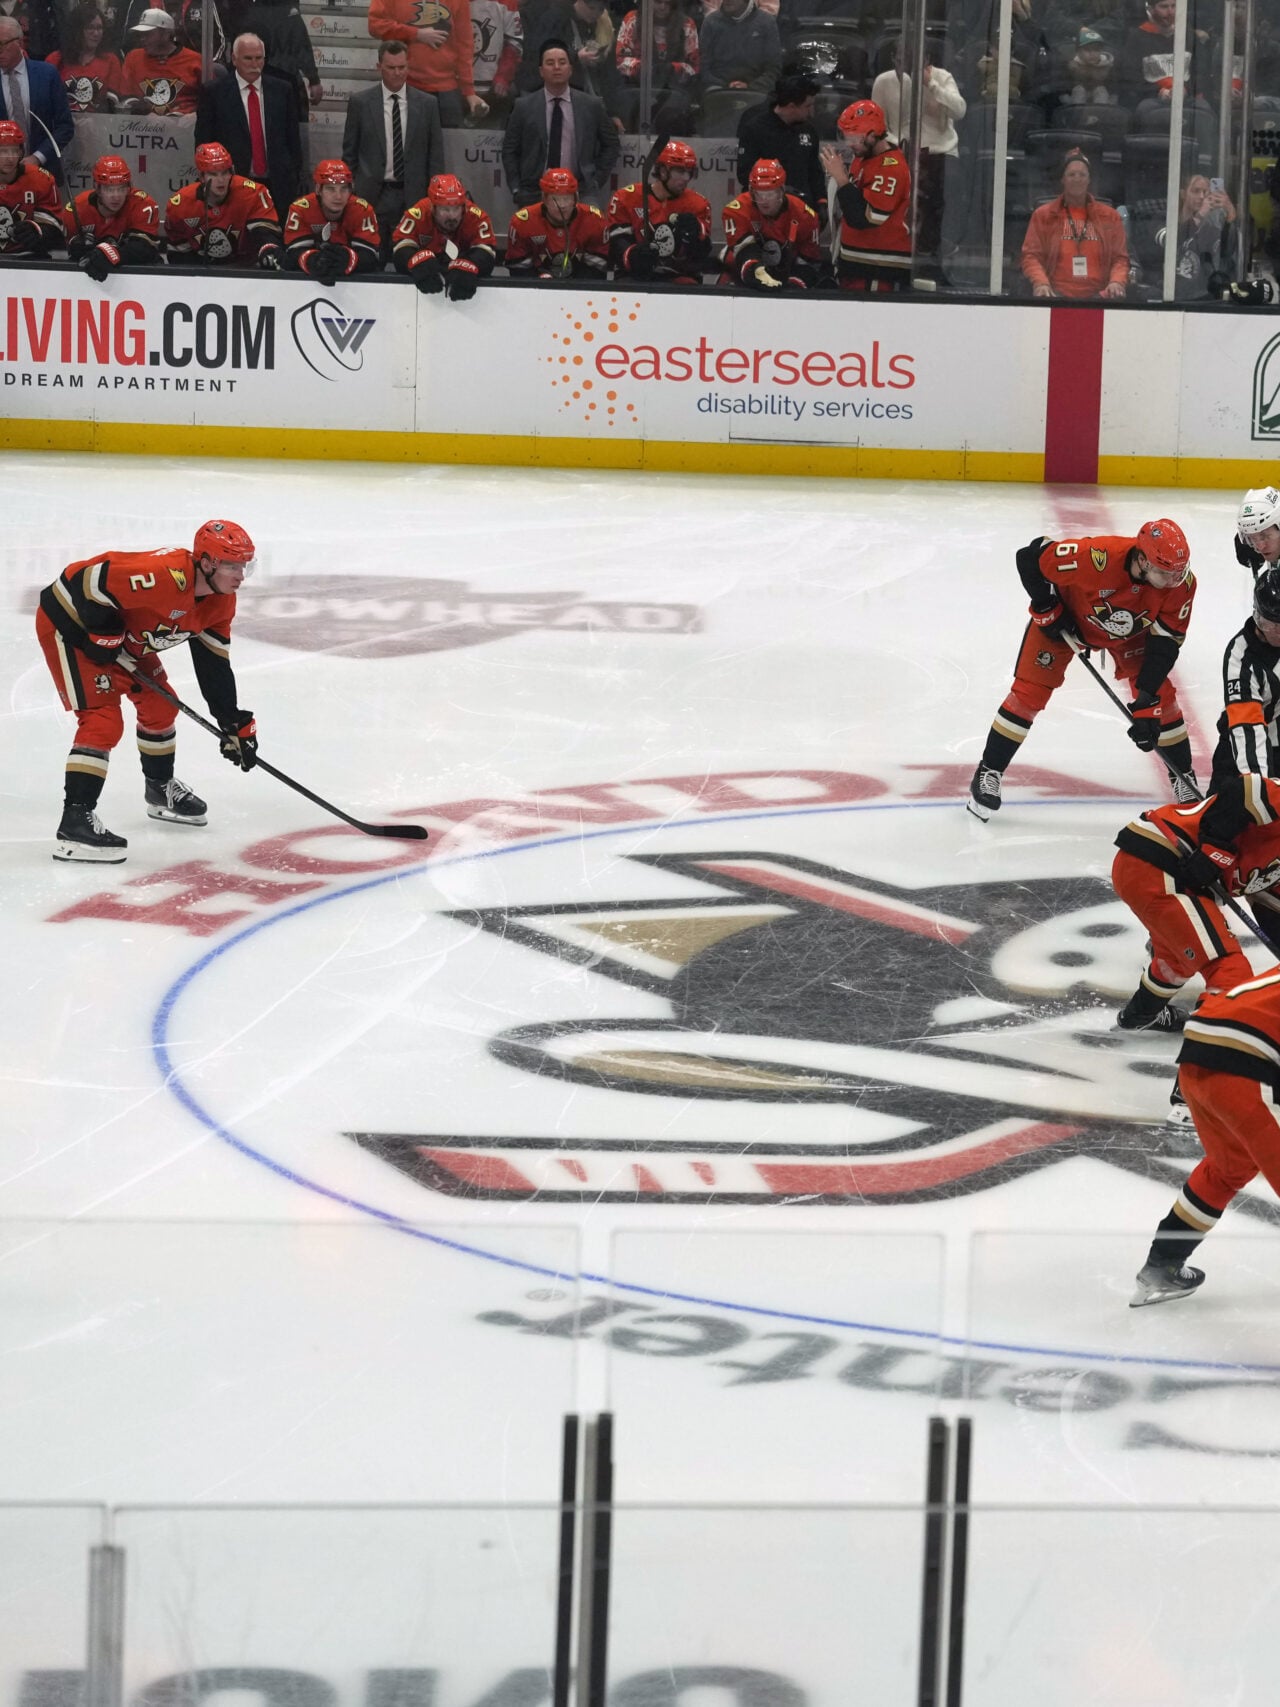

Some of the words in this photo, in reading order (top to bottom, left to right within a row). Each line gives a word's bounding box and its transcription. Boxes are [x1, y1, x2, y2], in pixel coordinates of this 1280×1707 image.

[321, 85, 349, 98] naheim
[109, 133, 179, 150] ULTRA
[464, 148, 502, 163] ULT
[700, 158, 739, 172] ULT
[871, 174, 897, 196] 23
[24, 190, 35, 204] A
[0, 296, 276, 371] IVING.COM
[594, 336, 916, 390] easterseals
[4, 372, 84, 388] DREAM
[97, 375, 238, 393] APARTMENT
[697, 392, 807, 422] disability
[813, 400, 914, 421] services
[1055, 542, 1079, 572] 61
[129, 571, 156, 592] 2
[1227, 680, 1241, 695] 24
[46, 762, 1158, 937] HONDA
